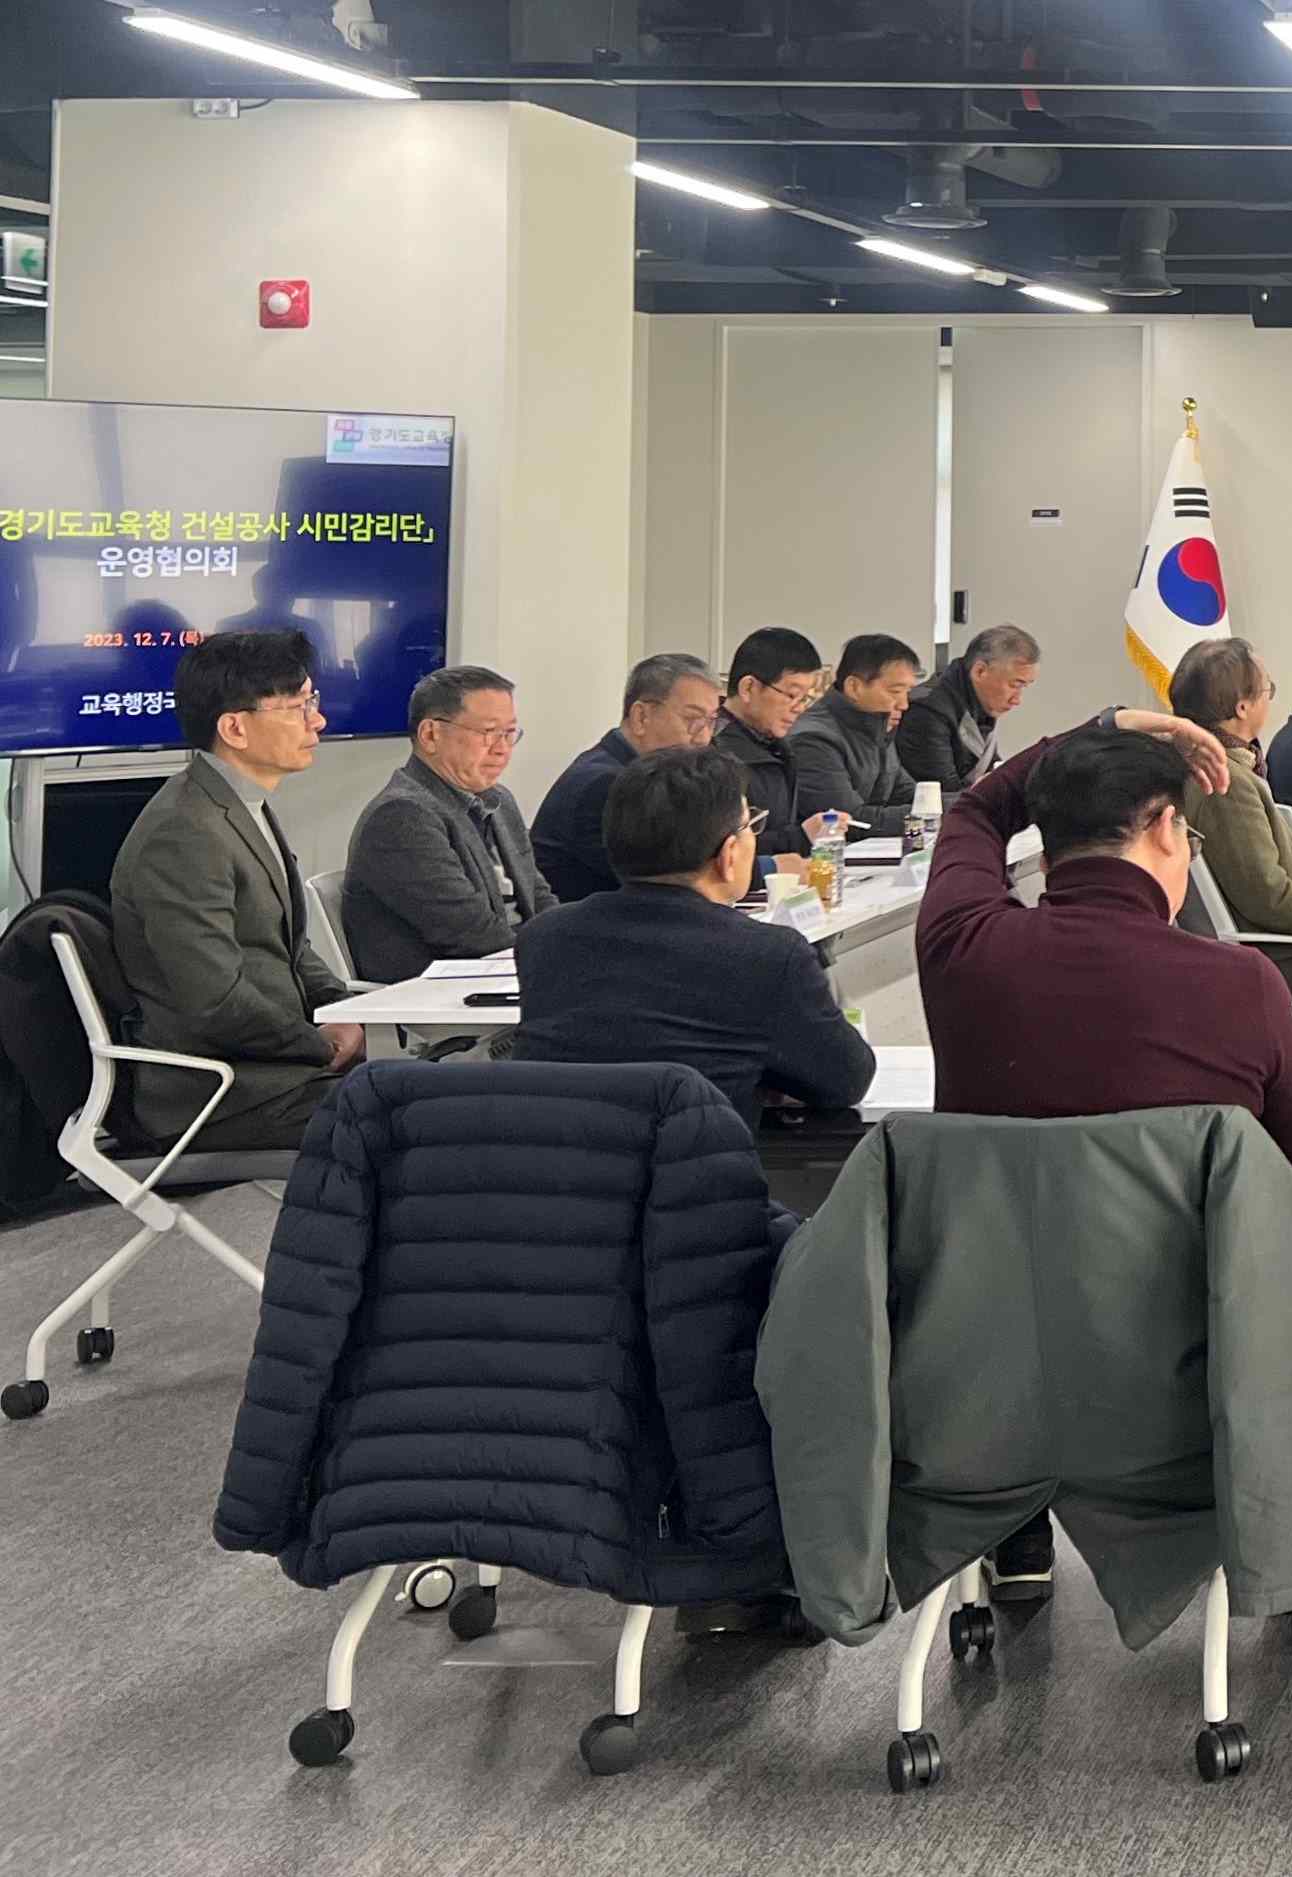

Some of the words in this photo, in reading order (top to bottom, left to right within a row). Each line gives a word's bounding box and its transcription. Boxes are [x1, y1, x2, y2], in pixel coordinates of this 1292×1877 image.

[181, 510, 290, 542] 건설공사
[297, 511, 434, 543] 시민감리단」
[97, 546, 238, 577] 운영협의회
[83, 633, 128, 647] 2023.
[133, 632, 156, 647] 12.
[161, 632, 175, 646] 7.
